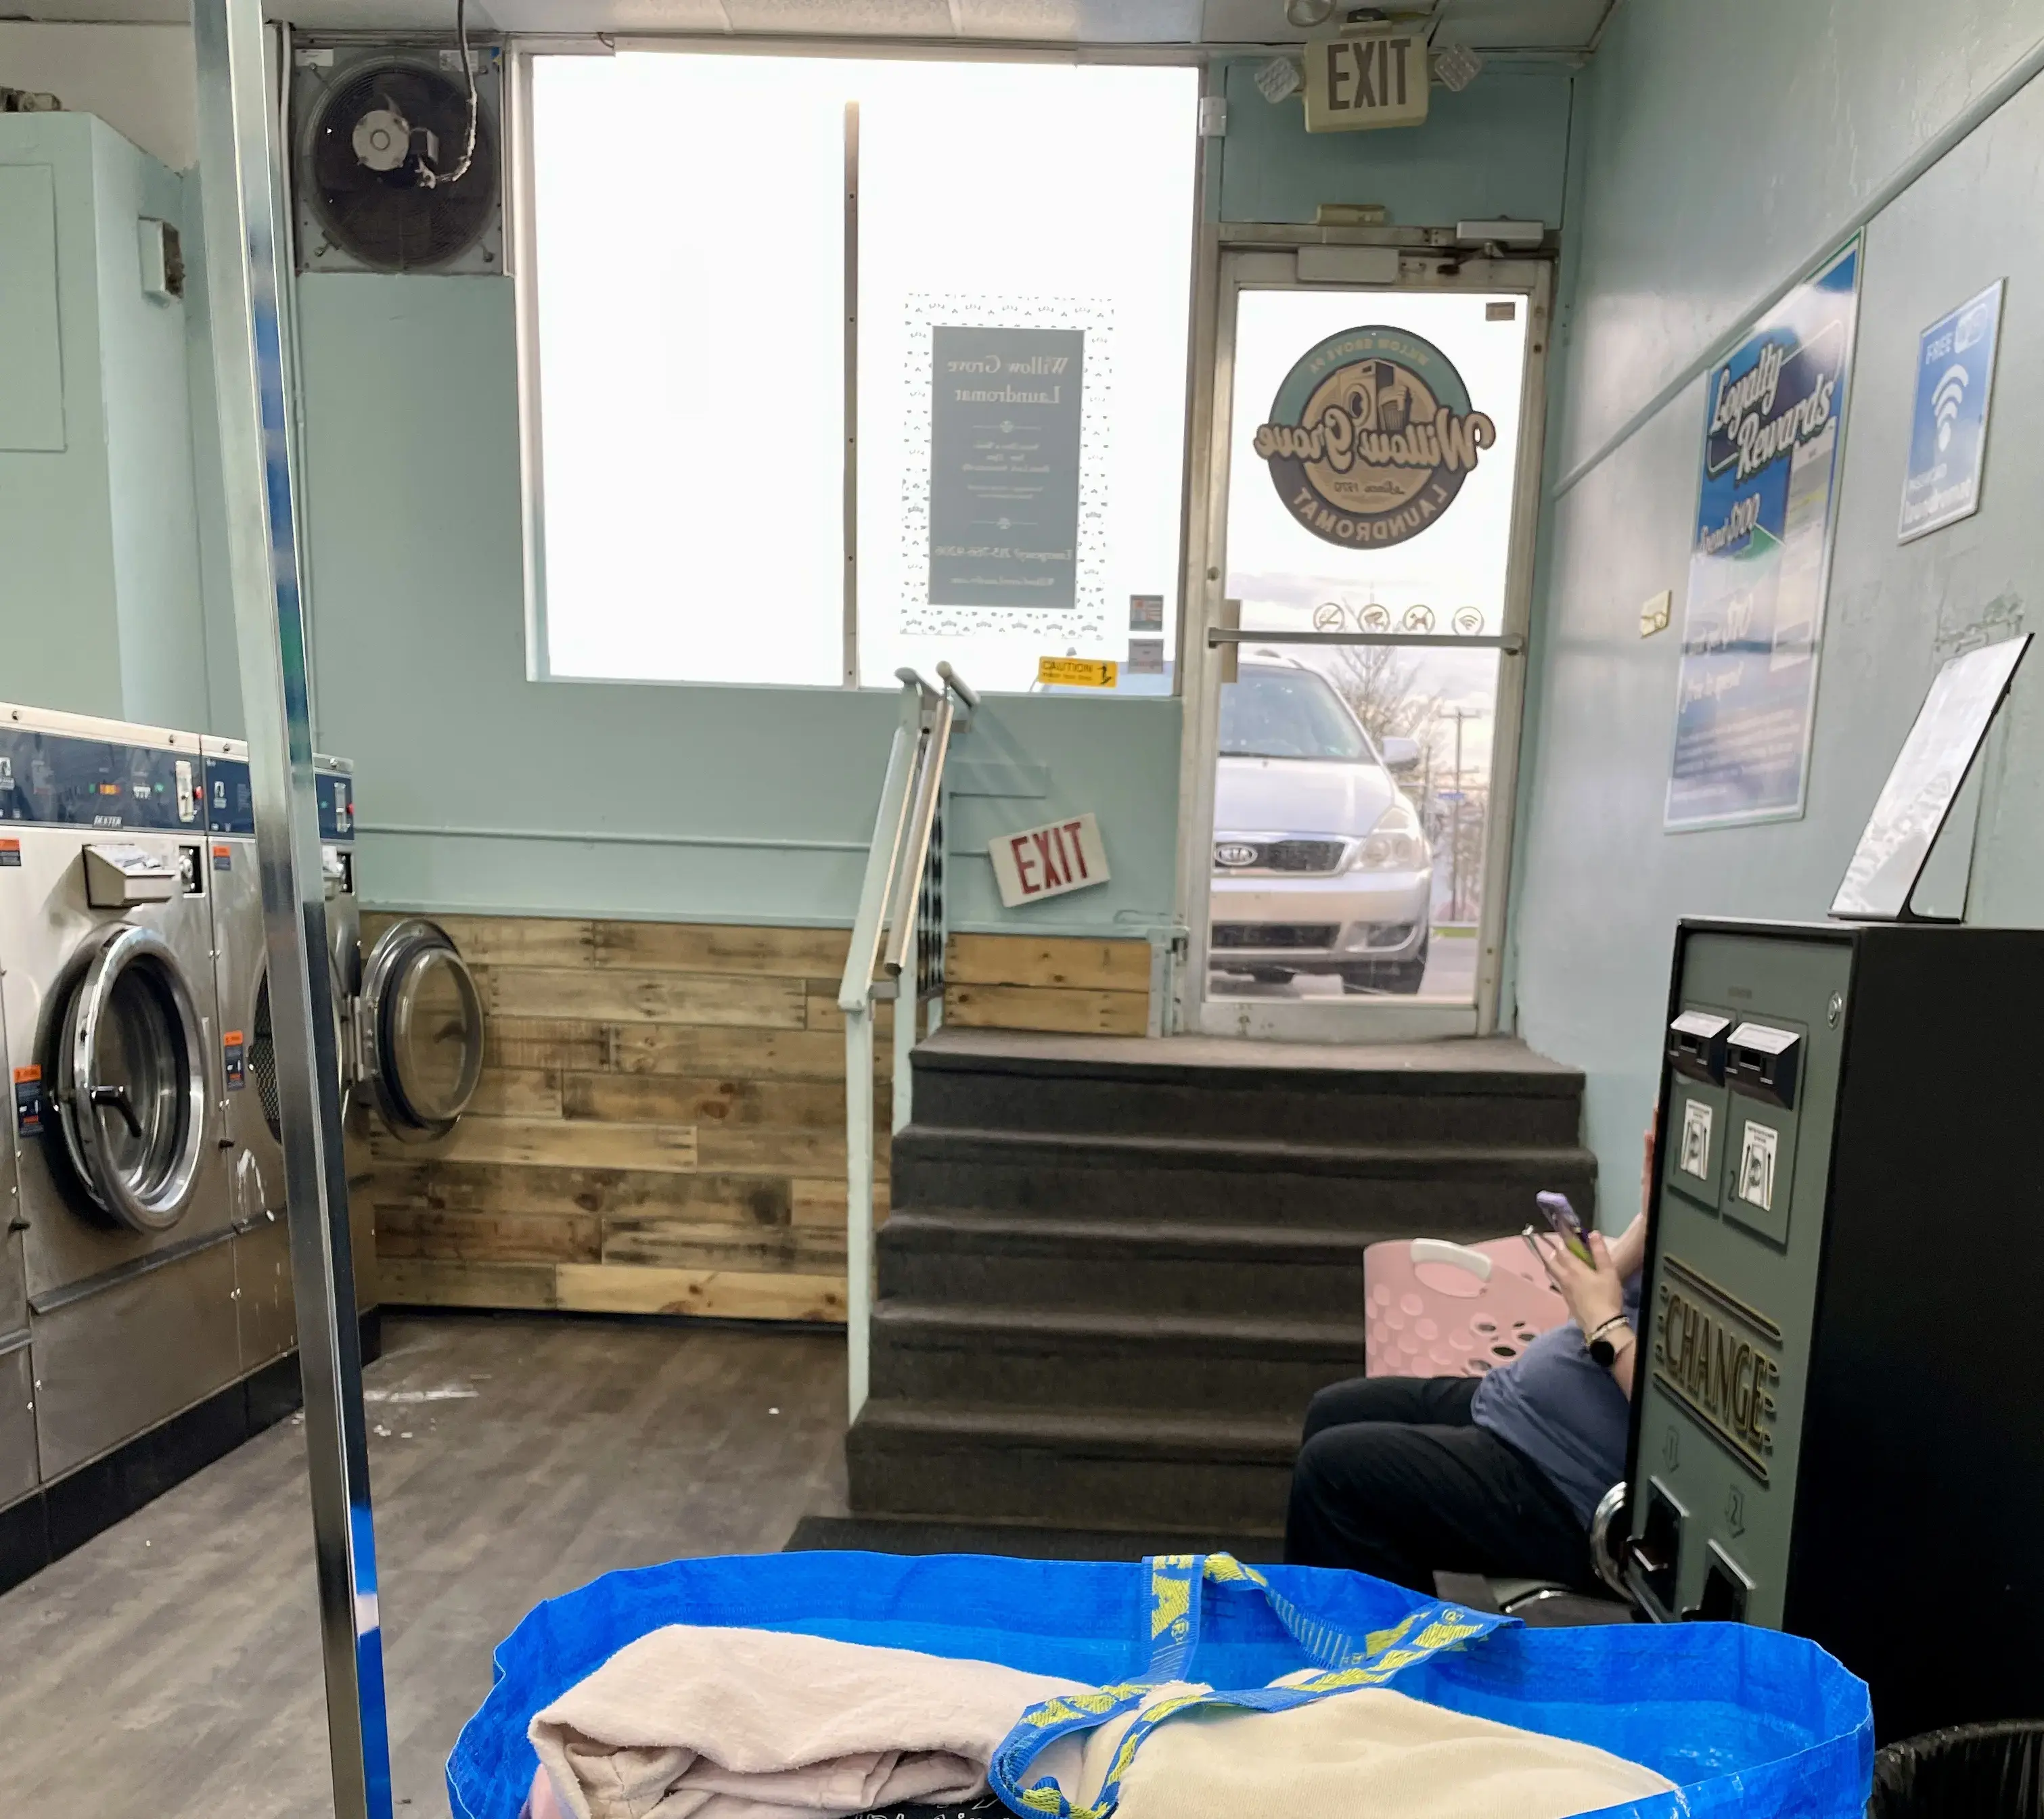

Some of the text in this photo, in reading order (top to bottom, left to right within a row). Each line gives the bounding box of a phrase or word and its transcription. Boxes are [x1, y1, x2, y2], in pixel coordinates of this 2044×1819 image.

[1327, 39, 1411, 110] EXIT
[1710, 343, 1783, 440] Loyalty
[1736, 373, 1835, 480] Rewards
[1041, 660, 1094, 673] CAUTION
[1010, 822, 1088, 894] EXIT
[1727, 1170, 1736, 1202] 2
[1665, 1292, 1767, 1441] CHANGE
